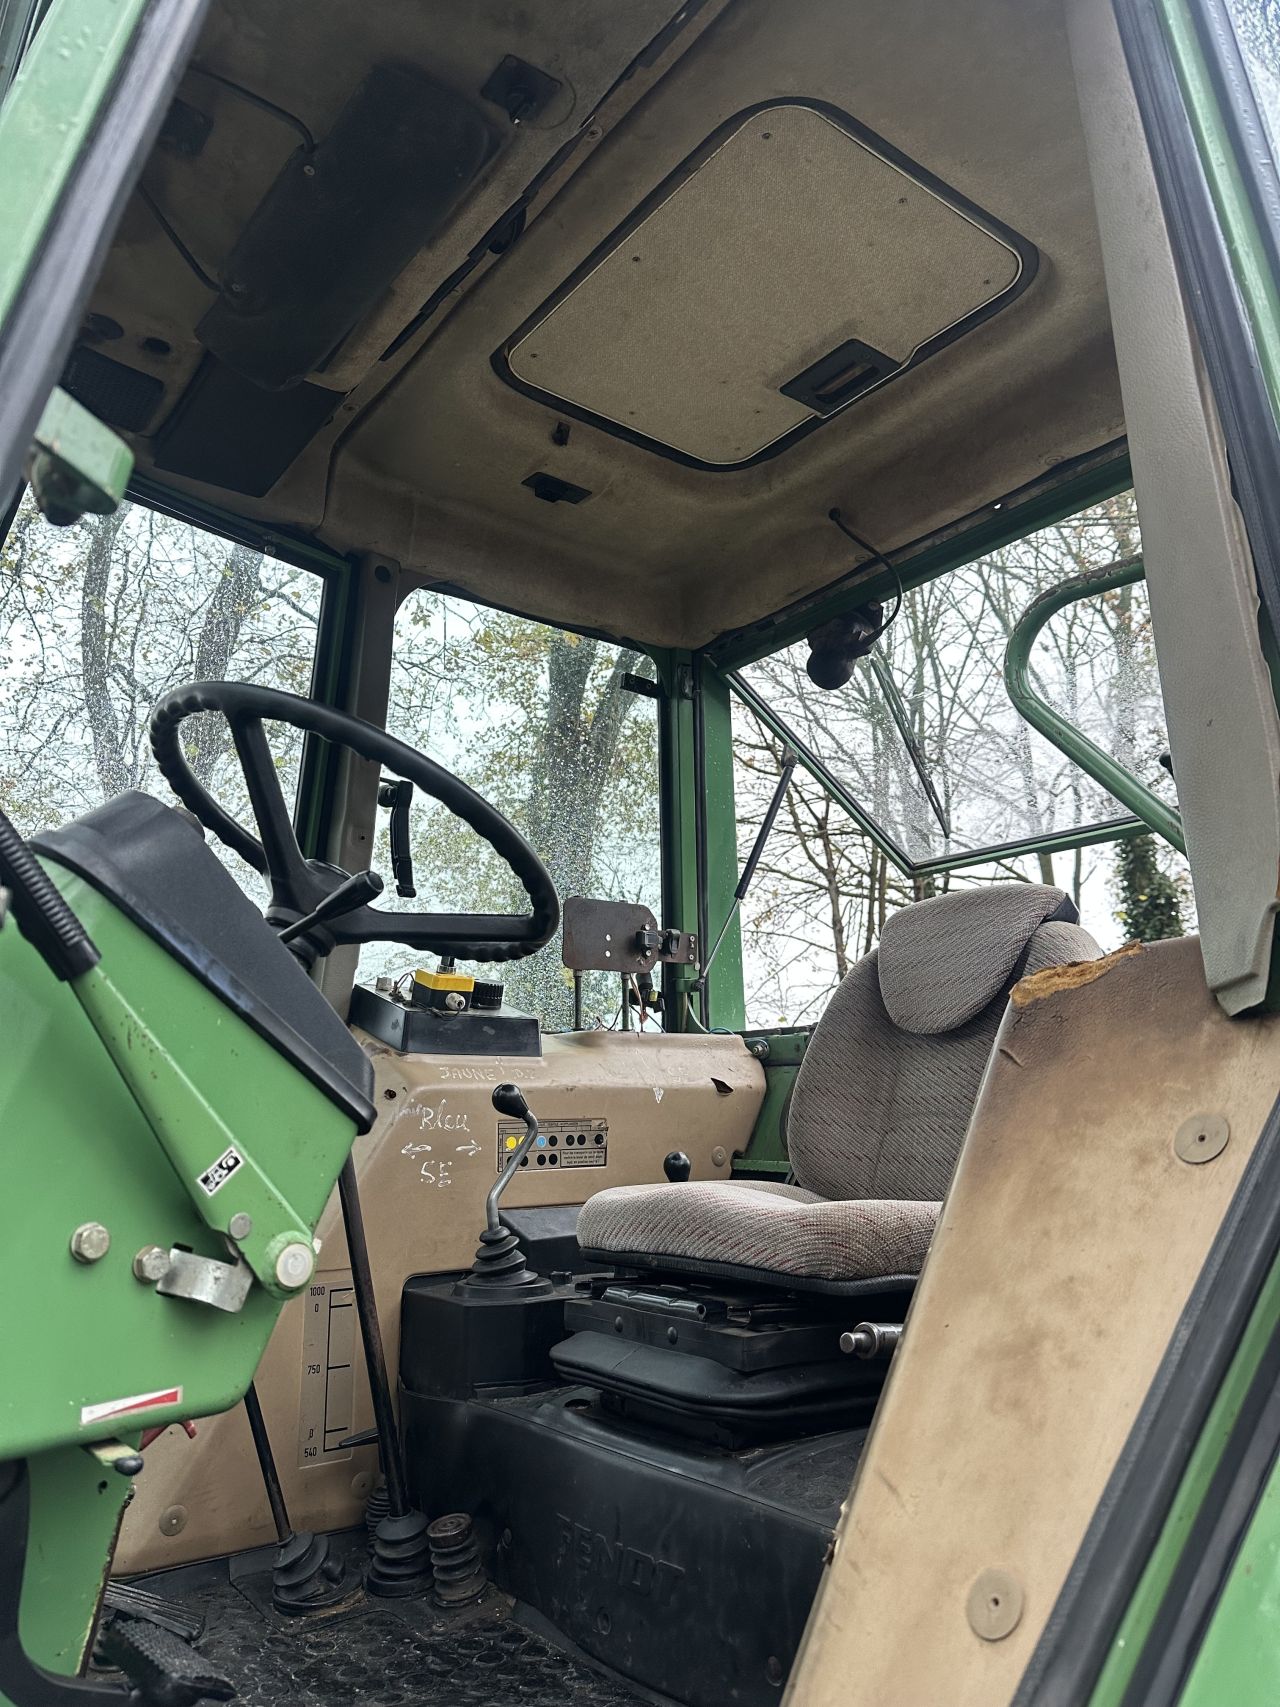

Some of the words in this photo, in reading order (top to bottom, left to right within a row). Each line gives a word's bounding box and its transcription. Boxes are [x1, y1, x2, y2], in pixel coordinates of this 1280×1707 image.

[439, 1066, 497, 1081] JAUNE
[310, 1286, 326, 1296] 1000
[314, 1303, 320, 1313] 0
[307, 1364, 321, 1375] 750
[304, 1446, 318, 1458] 540
[553, 1511, 686, 1603] FENDT
